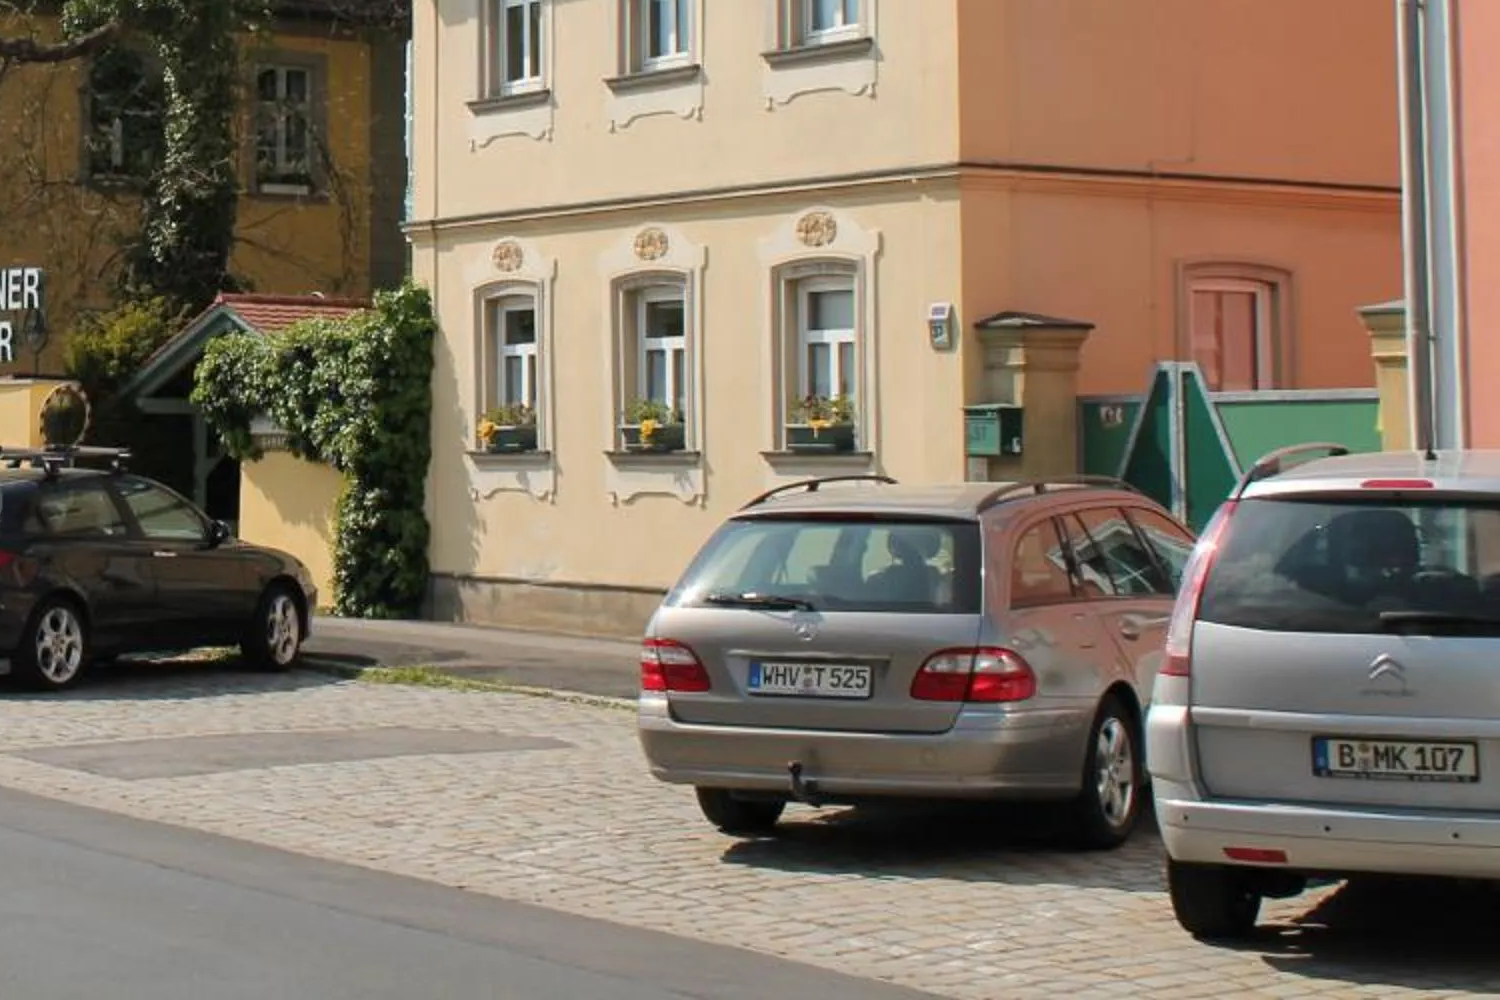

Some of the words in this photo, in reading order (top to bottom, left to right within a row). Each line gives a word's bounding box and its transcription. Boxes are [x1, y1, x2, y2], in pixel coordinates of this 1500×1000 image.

[762, 665, 800, 686] WHV
[814, 667, 826, 687] T
[829, 667, 868, 689] 525
[1338, 743, 1355, 768] B
[1373, 745, 1408, 771] MK
[1414, 746, 1463, 772] 107
